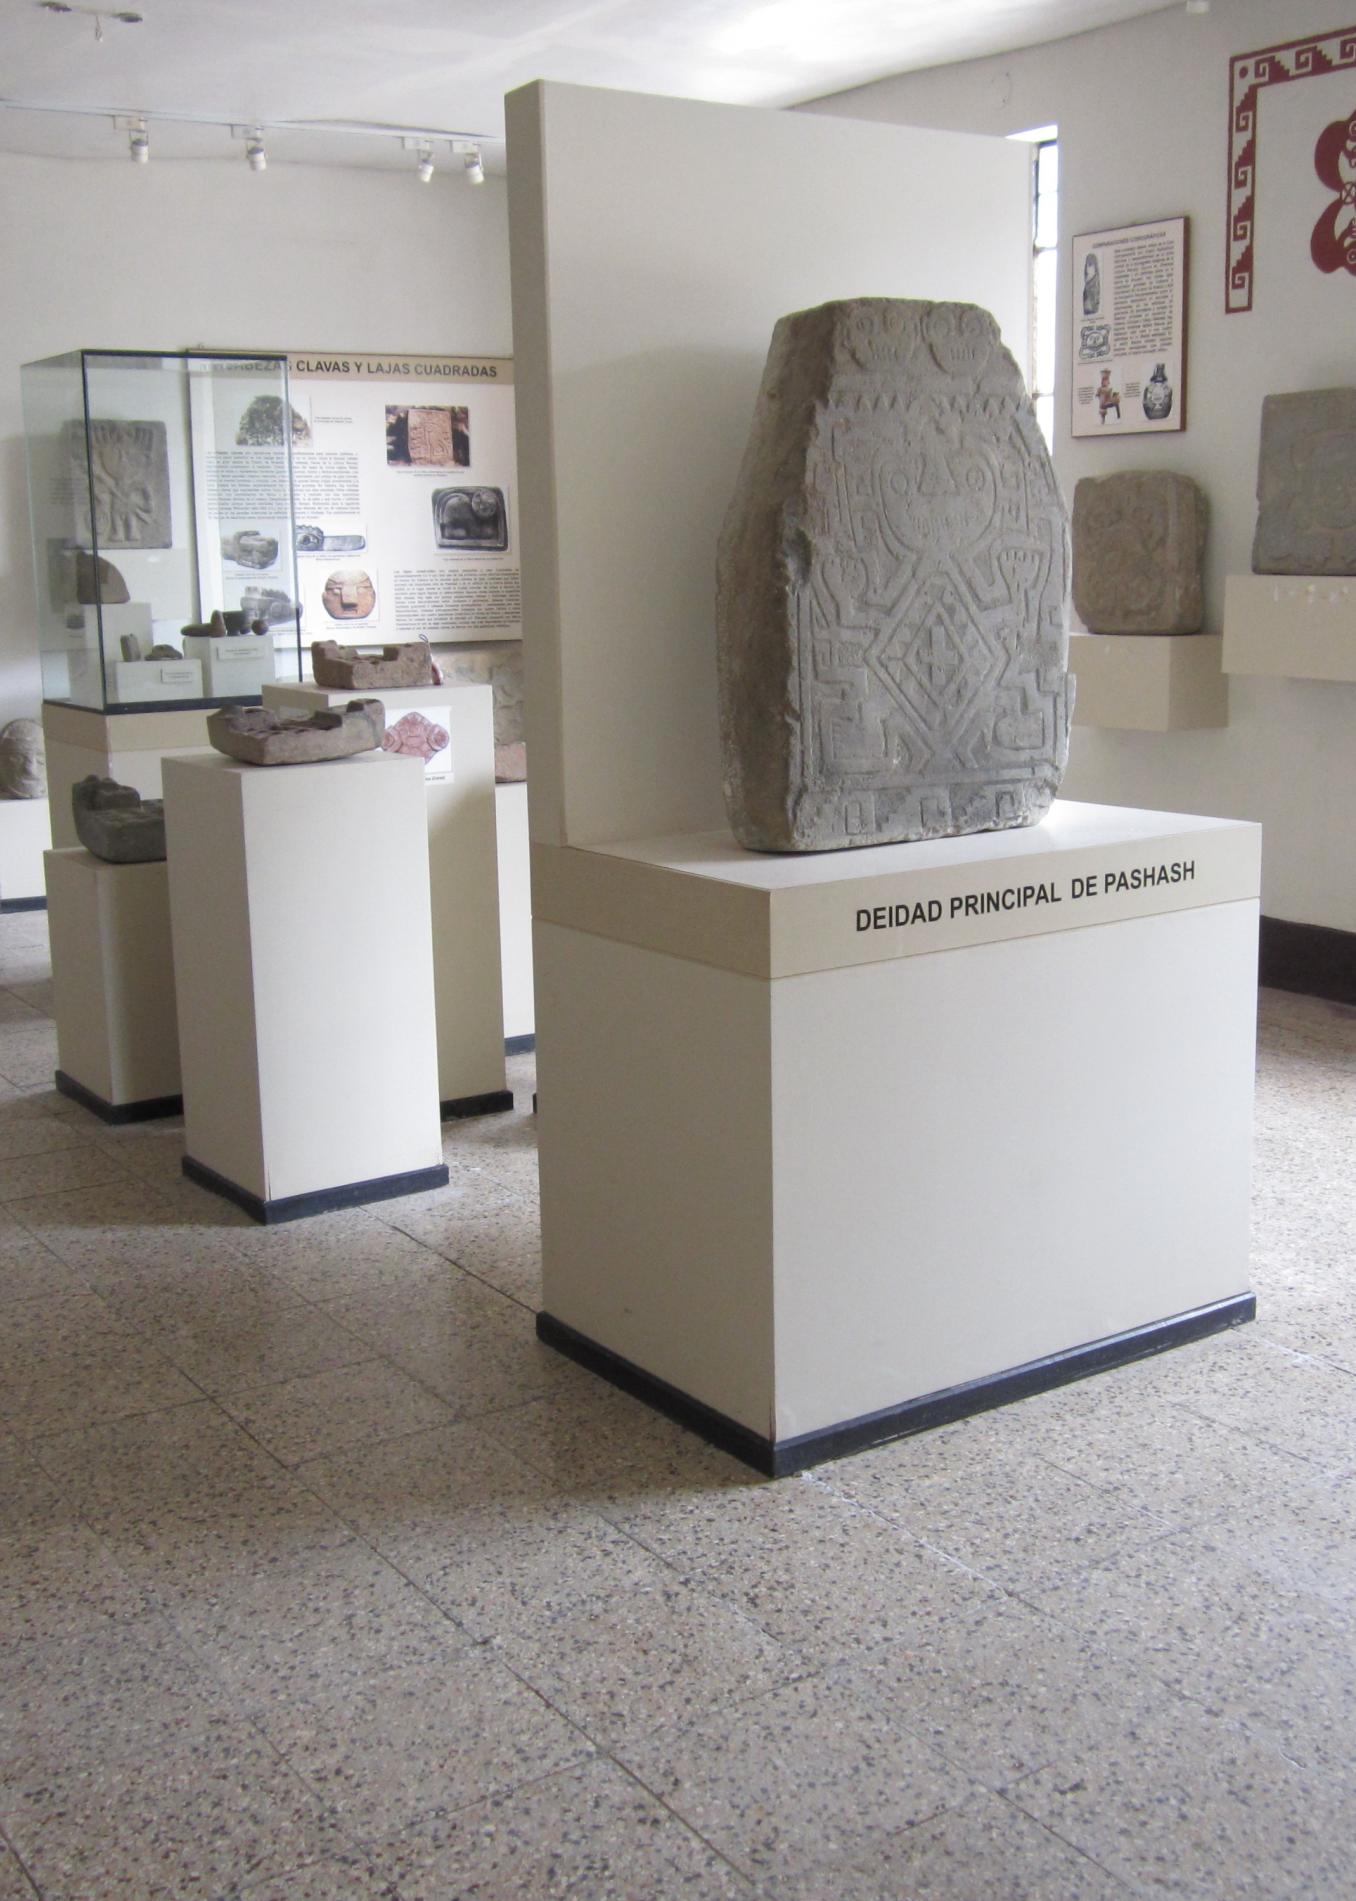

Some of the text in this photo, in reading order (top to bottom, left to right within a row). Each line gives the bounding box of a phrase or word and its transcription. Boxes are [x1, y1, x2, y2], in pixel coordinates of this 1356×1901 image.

[296, 360, 349, 373] CLAVAS
[354, 361, 363, 373] Y
[367, 362, 410, 375] LAJAS
[414, 363, 497, 377] CUADRADAS
[856, 861, 1196, 932] DEIDAD PRINCIPAL DE PASHASH
